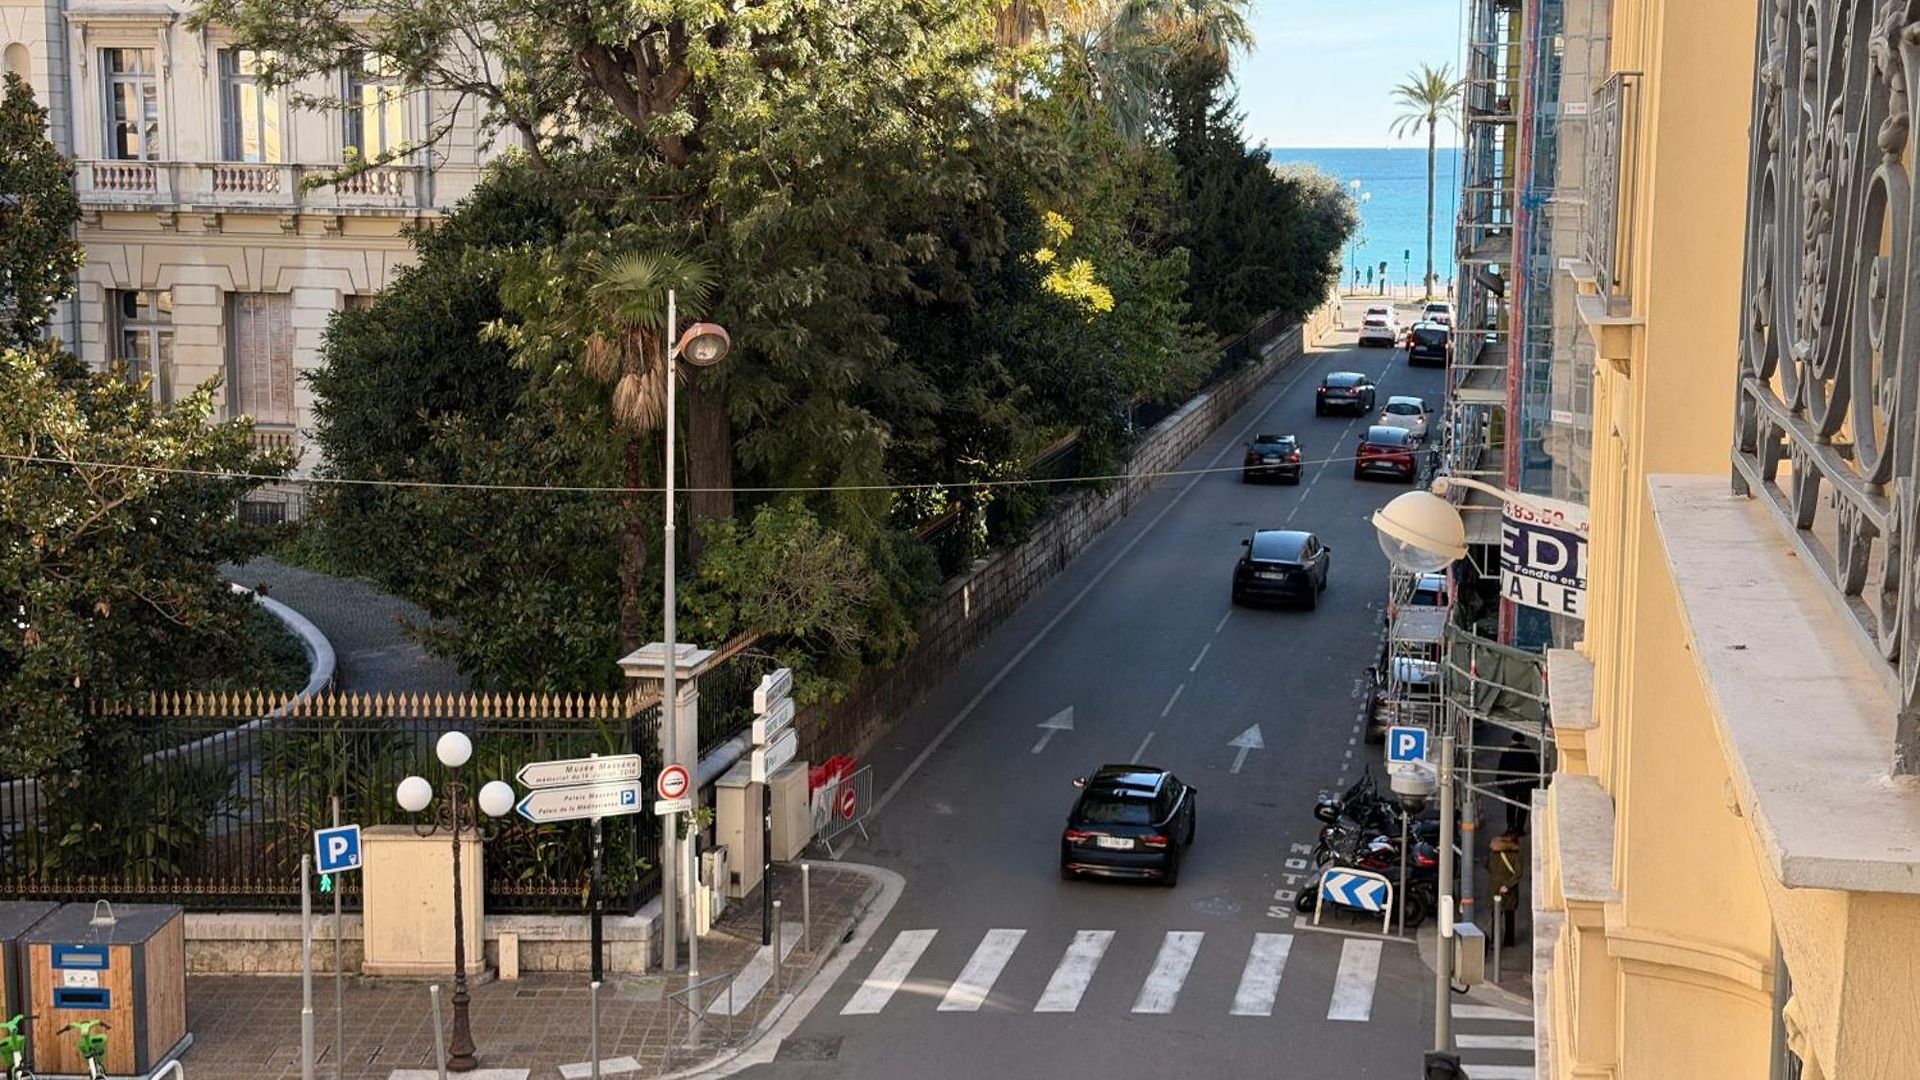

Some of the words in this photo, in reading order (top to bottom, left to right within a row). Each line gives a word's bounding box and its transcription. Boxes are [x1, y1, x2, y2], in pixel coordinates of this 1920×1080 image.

[1514, 564, 1557, 582] Fondée
[1560, 577, 1575, 586] en
[1399, 734, 1416, 756] P
[565, 765, 594, 773] Musée
[623, 791, 633, 804] P
[329, 836, 348, 864] P
[1266, 843, 1312, 918] MOTOS
